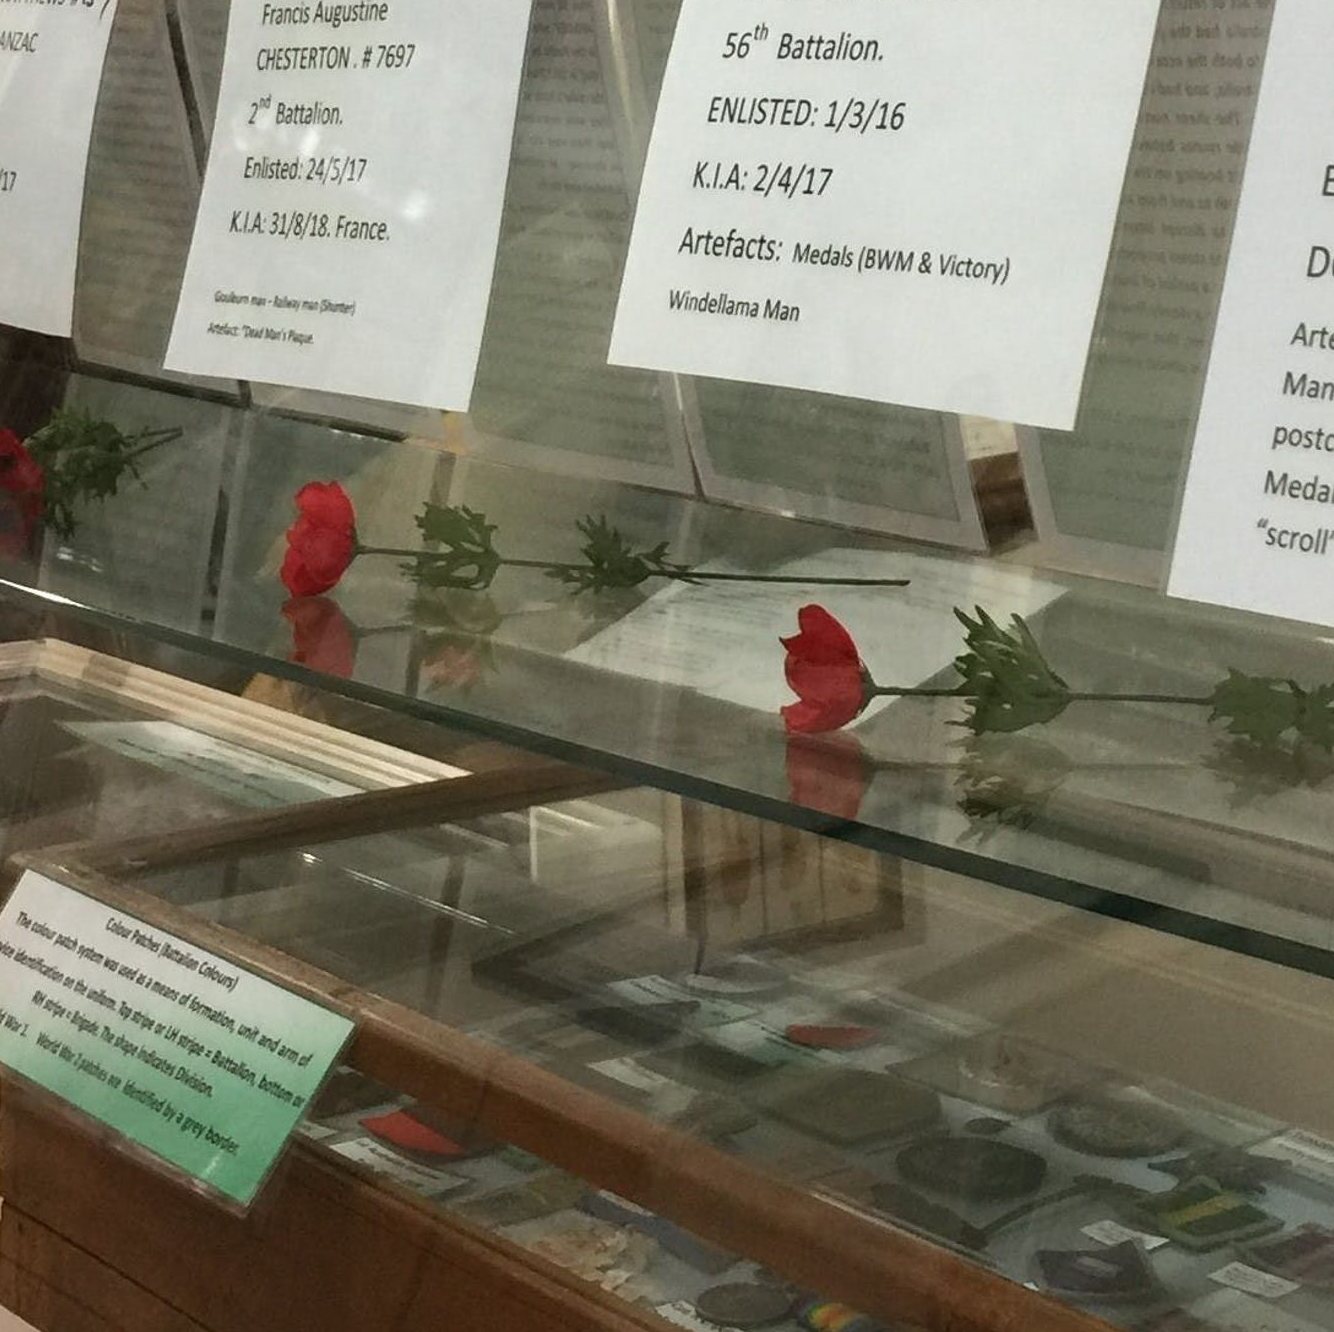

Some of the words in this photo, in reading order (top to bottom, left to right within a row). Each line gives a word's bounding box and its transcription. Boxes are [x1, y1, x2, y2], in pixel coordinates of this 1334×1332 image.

[262, 1, 310, 24] Francis
[313, 0, 388, 28] Augustine
[377, 44, 415, 68] 7697
[722, 22, 769, 59] 56th
[777, 32, 883, 61] Battalion.
[248, 94, 272, 124] 2nd
[276, 101, 343, 126] Battalion.
[707, 97, 818, 127] ENLISTED:
[824, 98, 906, 134] 1/3/16
[244, 156, 303, 180] Enlisted:
[306, 156, 367, 185] 24/5/17
[693, 161, 748, 191] K.I.A:
[753, 162, 833, 199] 2/4/17
[335, 215, 389, 241] France.
[678, 227, 783, 262] Artefacts:
[792, 242, 853, 267] Medals
[858, 246, 914, 273] (BWM
[919, 254, 932, 274] &
[940, 254, 1010, 285] Victory)
[670, 290, 759, 318] Windellama
[763, 298, 800, 322] Man
[16, 911, 30, 929] The
[179, 991, 193, 1006] of
[238, 1024, 260, 1042] unit
[258, 1034, 281, 1053] and
[277, 1047, 298, 1064] arm
[199, 961, 239, 994] Colours)
[257, 1077, 294, 1103] bottom
